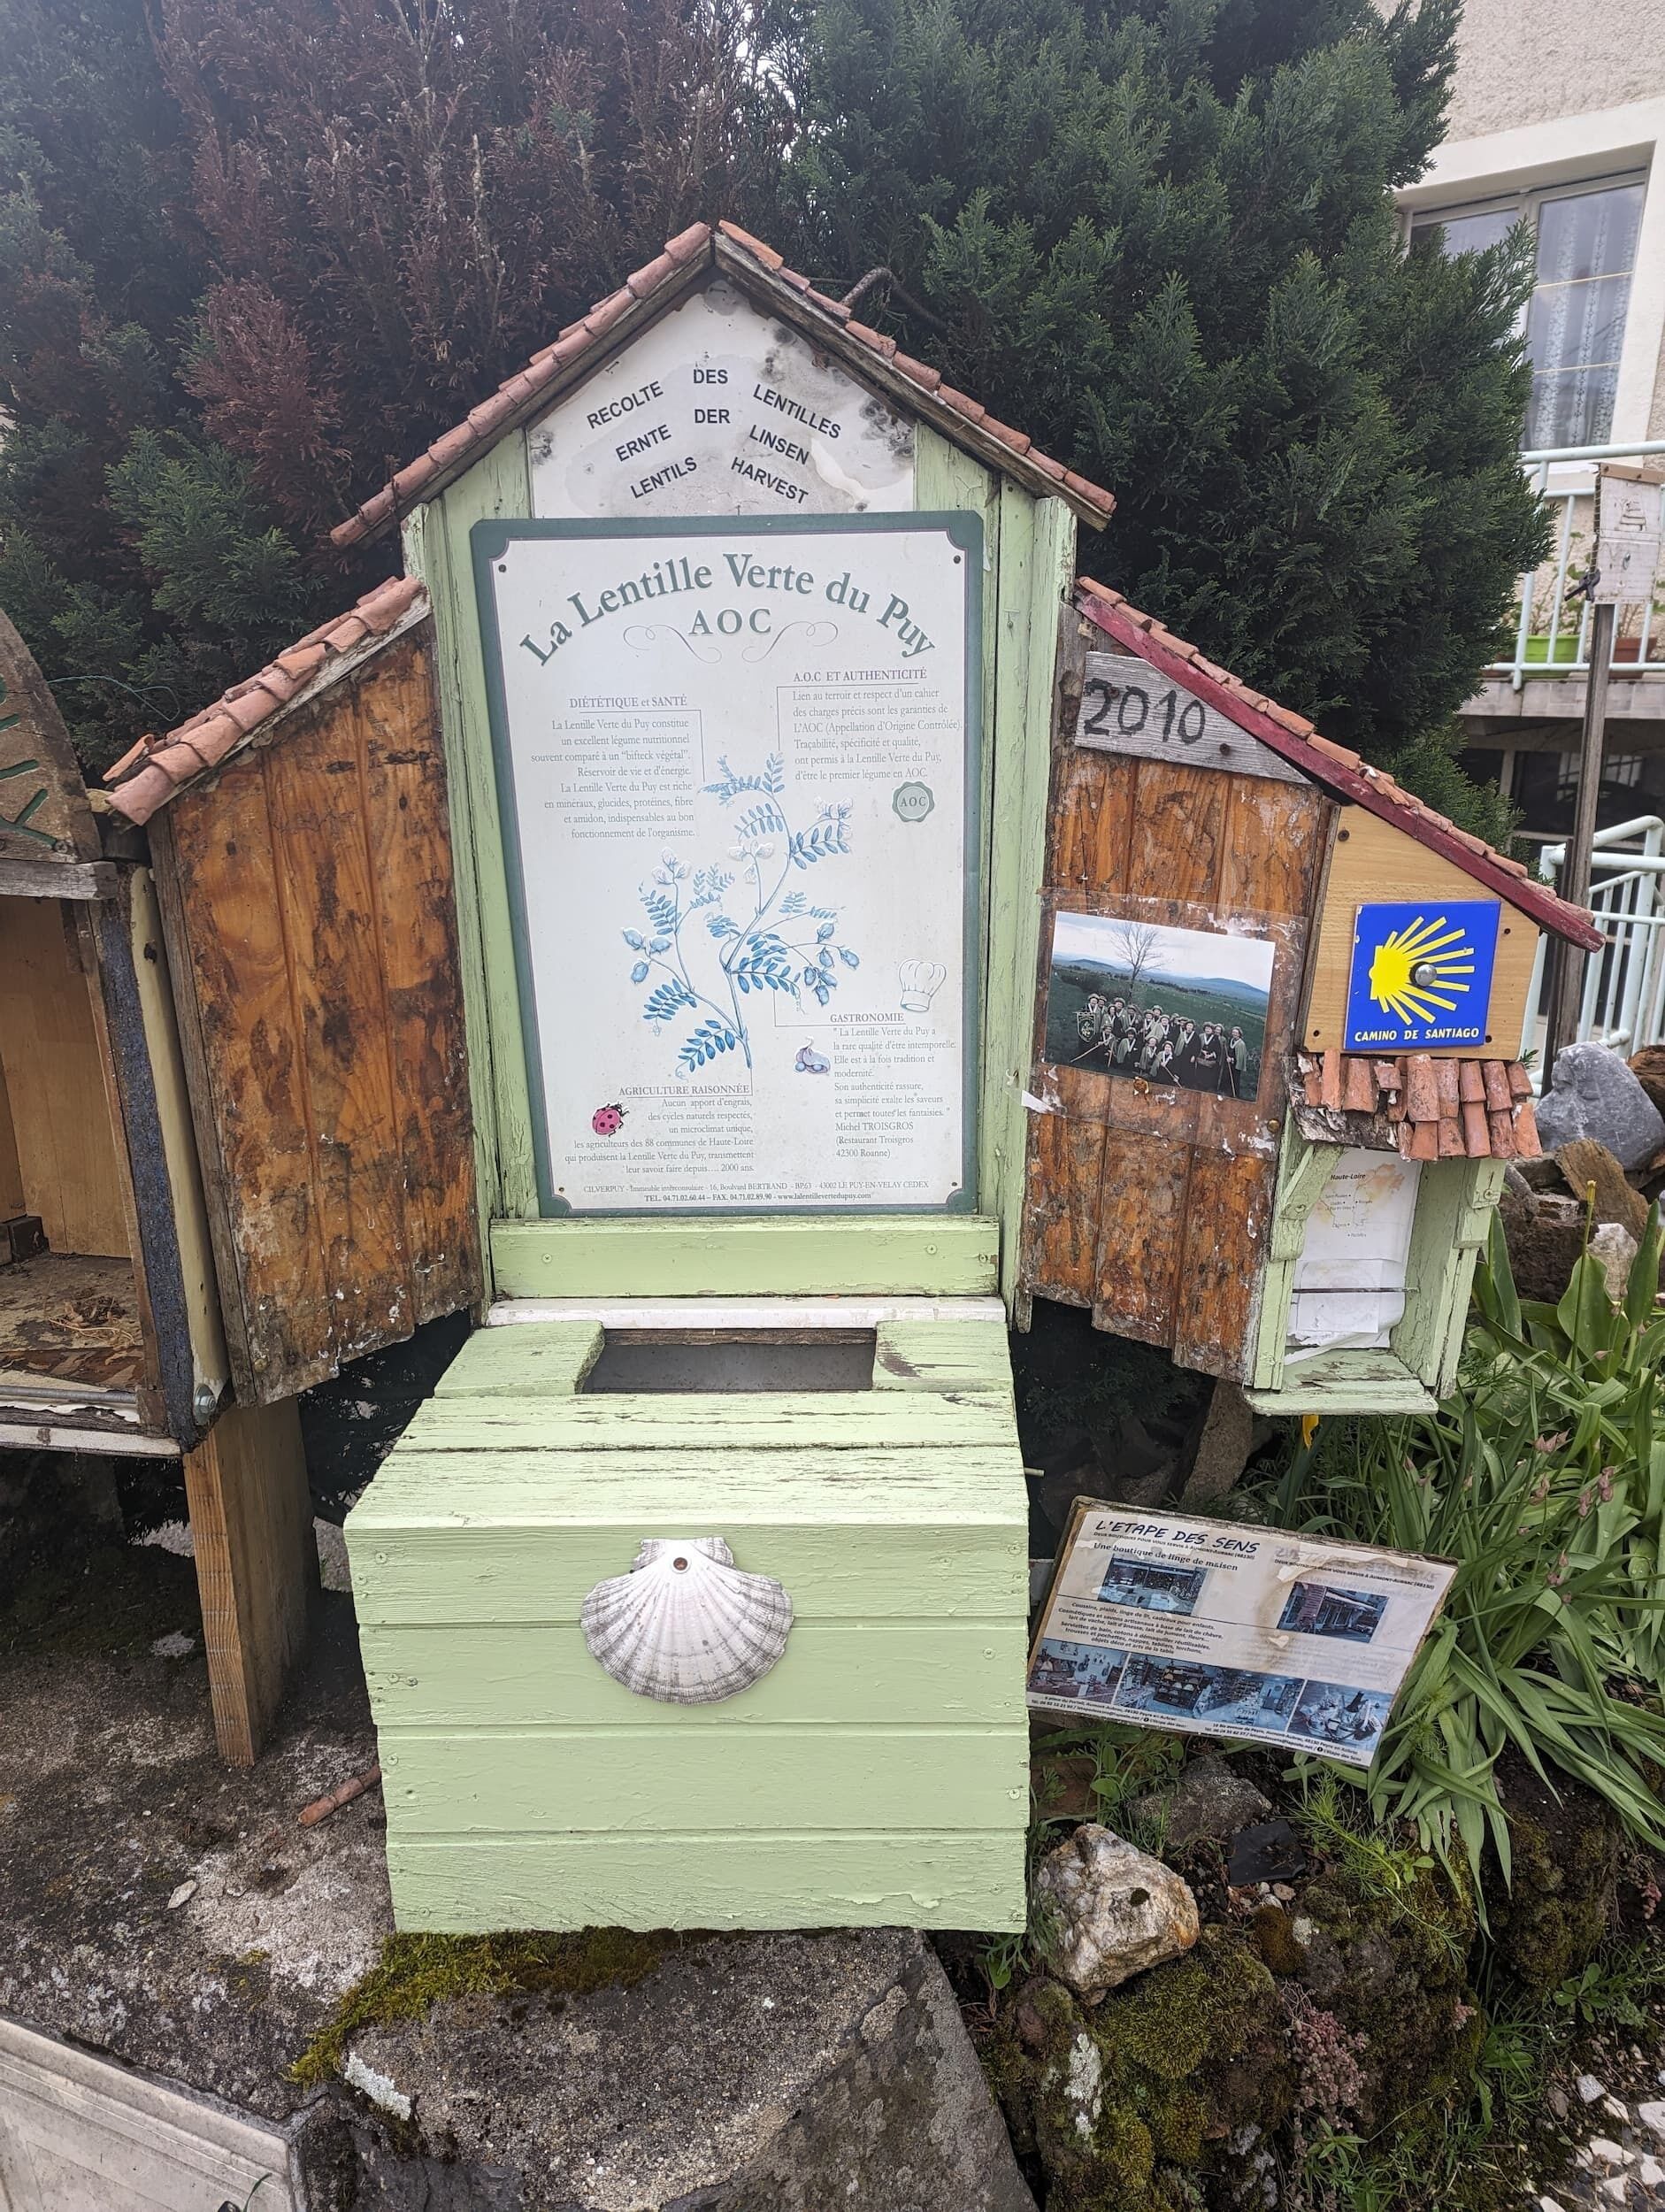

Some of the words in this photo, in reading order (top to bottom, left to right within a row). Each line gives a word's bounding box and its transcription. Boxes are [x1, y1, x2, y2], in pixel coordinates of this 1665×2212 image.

[586, 381, 664, 429] RECOLTE
[693, 368, 728, 384] DES
[753, 384, 841, 439] LENTILLES
[616, 424, 671, 461] ERNTE
[694, 409, 731, 424] DER
[749, 425, 809, 465] LINSEN
[630, 457, 697, 499] LENTILS
[731, 457, 809, 504] HARVEST
[519, 619, 572, 665] La
[567, 557, 712, 626] Lentille
[723, 553, 814, 595] Verte
[825, 572, 871, 614] du
[876, 593, 935, 658] Puy
[688, 608, 773, 635] AOC
[794, 672, 821, 682] A.O.C
[826, 672, 840, 680] ET
[843, 667, 927, 680] AUTHENTICITÉ
[570, 696, 638, 709] DIÉTÉTIQUE
[641, 697, 649, 706] et
[652, 694, 687, 706] SANTÉ
[794, 691, 811, 701] Lien
[825, 691, 850, 700] terroir
[863, 691, 892, 702] respect
[915, 688, 940, 697] cahier
[794, 708, 806, 717] des
[809, 707, 839, 718] charges
[842, 707, 865, 718] précis
[901, 705, 936, 717] garanties
[939, 704, 948, 713] de
[1084, 678, 1205, 745] 2010
[552, 720, 562, 729] La
[565, 719, 595, 729] Lentille
[597, 719, 618, 728] Verte
[622, 718, 632, 728] du
[634, 718, 649, 730] Puy
[826, 722, 875, 734] (Appellation
[574, 736, 609, 745] excellent
[611, 735, 641, 747] légume
[643, 733, 689, 743] nutritionnel
[840, 738, 879, 749] spécificité
[531, 753, 563, 762] souvent
[565, 751, 600, 764] comparé
[811, 757, 838, 765] permis
[856, 754, 886, 763] Lentille
[888, 753, 909, 762] Verte
[925, 752, 941, 764] Puy,
[578, 767, 616, 776] Réservoir
[820, 771, 826, 780] le
[830, 770, 860, 781] premier
[863, 770, 891, 780] légume
[574, 782, 602, 792] Lentille
[606, 782, 626, 791] Verte
[630, 782, 640, 791] du
[642, 781, 656, 793] Puy
[672, 781, 692, 790] riche
[901, 797, 925, 807] AOC
[609, 814, 664, 825] indispensables
[830, 1013, 904, 1023] GASTRONOMIE
[1354, 1031, 1397, 1041] CAMINO
[1404, 1030, 1418, 1040] DE
[1425, 1028, 1479, 1039] SANTIAGO
[619, 1086, 689, 1096] AGRICULTURE
[692, 1084, 749, 1094] RAISONNÉE
[691, 1099, 714, 1109] apport
[648, 1112, 661, 1121] des
[663, 1112, 684, 1122] cycles
[587, 1140, 628, 1149] agriculteurs
[836, 1137, 877, 1146] (Restaurant
[879, 1136, 913, 1146] Troisgros
[565, 1155, 576, 1164] qui
[579, 1154, 618, 1164] produisent
[1173, 1530, 1207, 1546] DES
[1214, 1537, 1260, 1554] SENS
[1093, 1543, 1111, 1553] Une
[1113, 1546, 1152, 1559] boutique
[1154, 1551, 1167, 1560] de
[1168, 1553, 1193, 1564] linge
[1194, 1557, 1207, 1566] de
